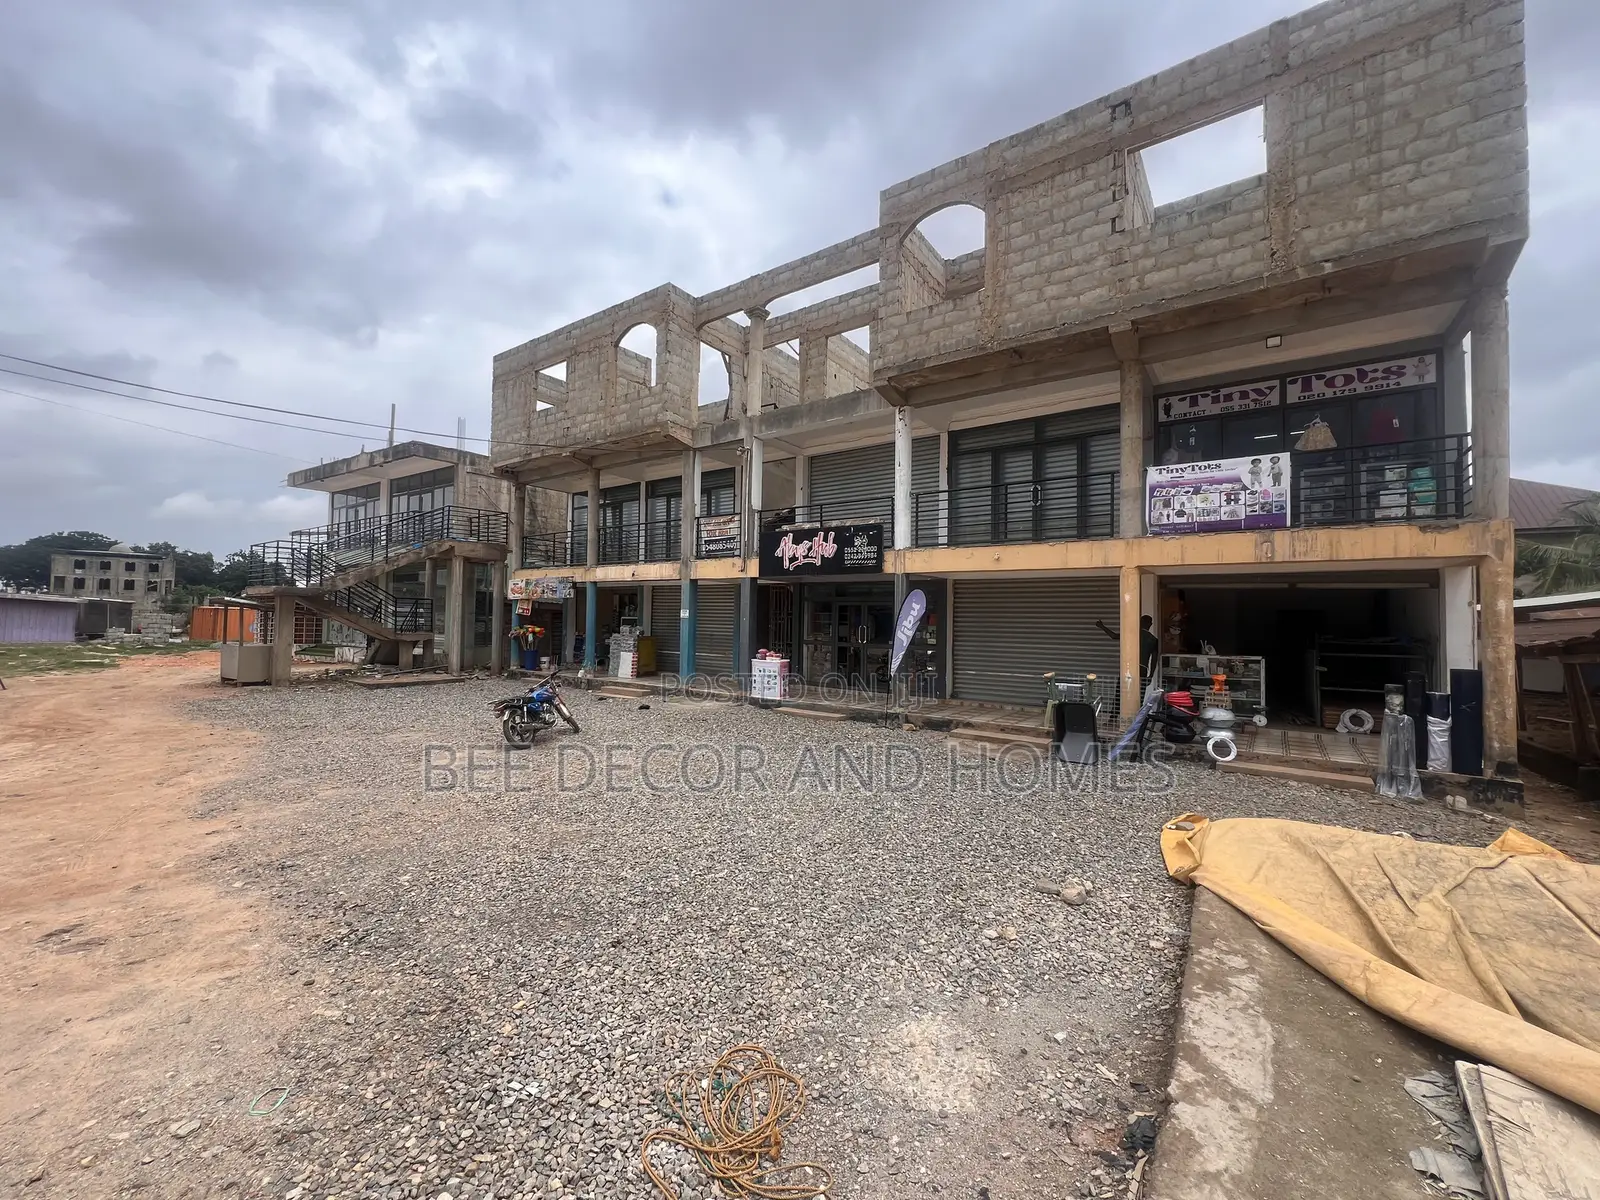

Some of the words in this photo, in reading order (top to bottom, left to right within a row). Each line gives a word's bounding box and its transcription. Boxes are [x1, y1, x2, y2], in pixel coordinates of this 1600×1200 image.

[1178, 384, 1278, 408] Tiny
[1287, 364, 1407, 394] Tots
[1297, 392, 1326, 401] 020
[1331, 387, 1357, 396] 179
[1363, 381, 1402, 391] 9914
[1173, 409, 1207, 420] CONTACT
[1238, 403, 1251, 411] 331
[808, 531, 838, 566] Hub
[896, 602, 921, 646] Jibu
